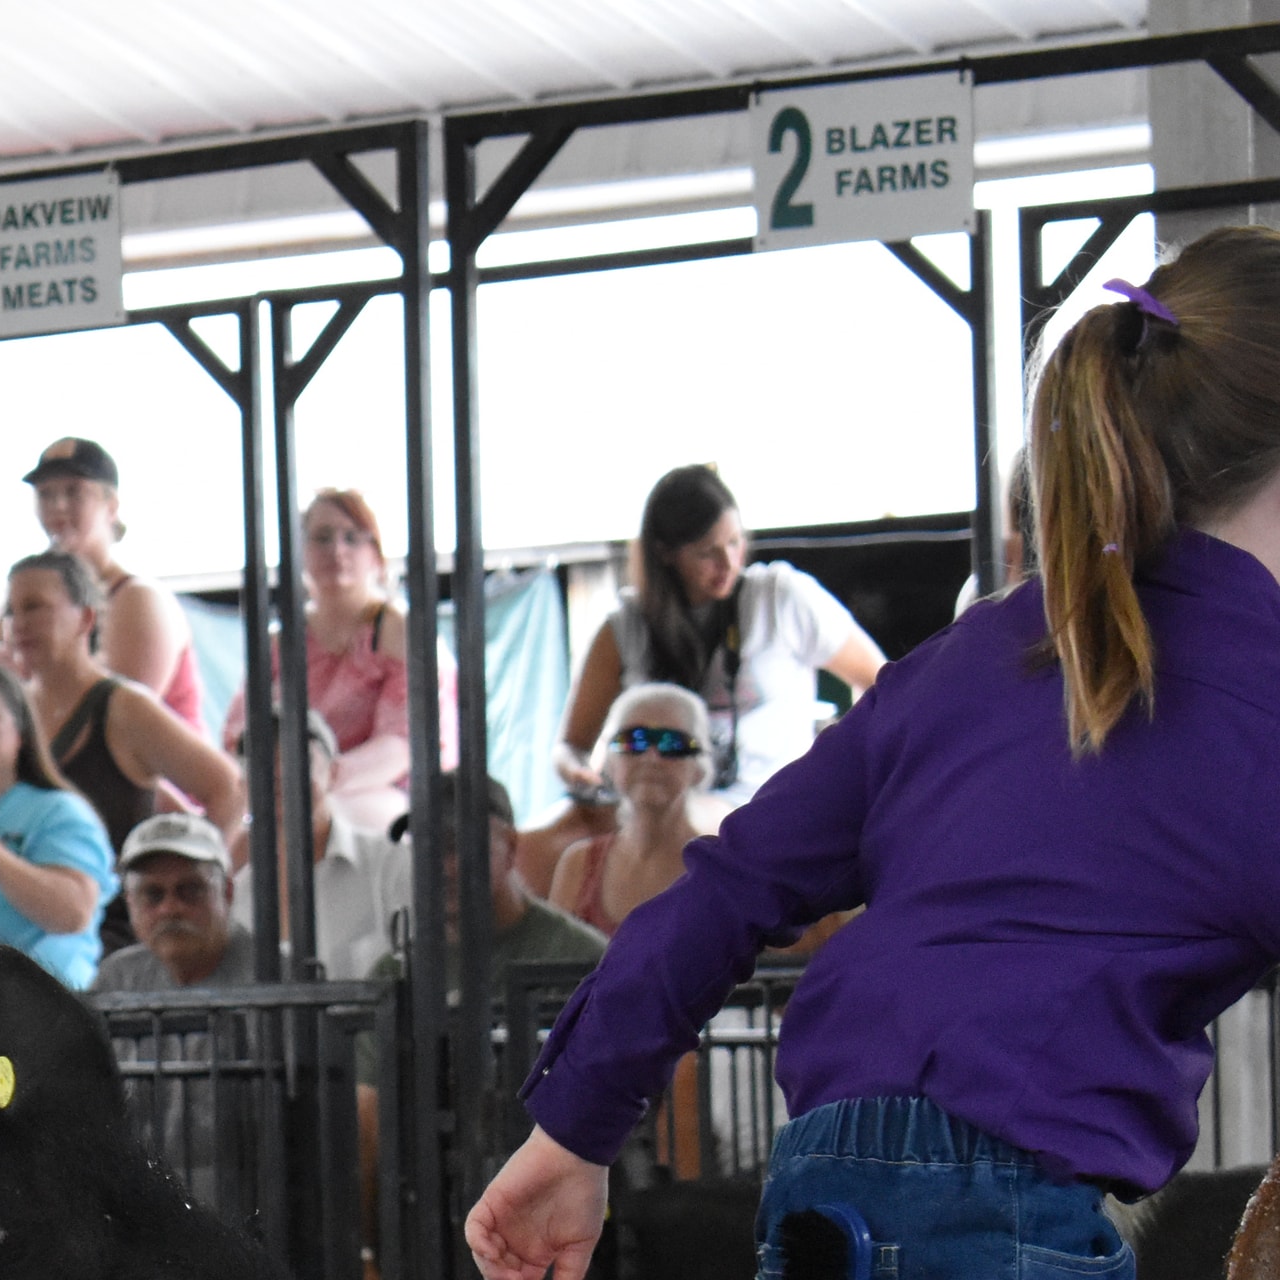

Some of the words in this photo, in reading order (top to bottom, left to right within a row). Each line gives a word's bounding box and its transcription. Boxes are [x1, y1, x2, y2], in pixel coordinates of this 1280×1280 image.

[825, 116, 957, 154] BLAZER
[768, 106, 813, 230] 2
[835, 159, 950, 196] FARMS
[1, 276, 98, 310] MEATS
